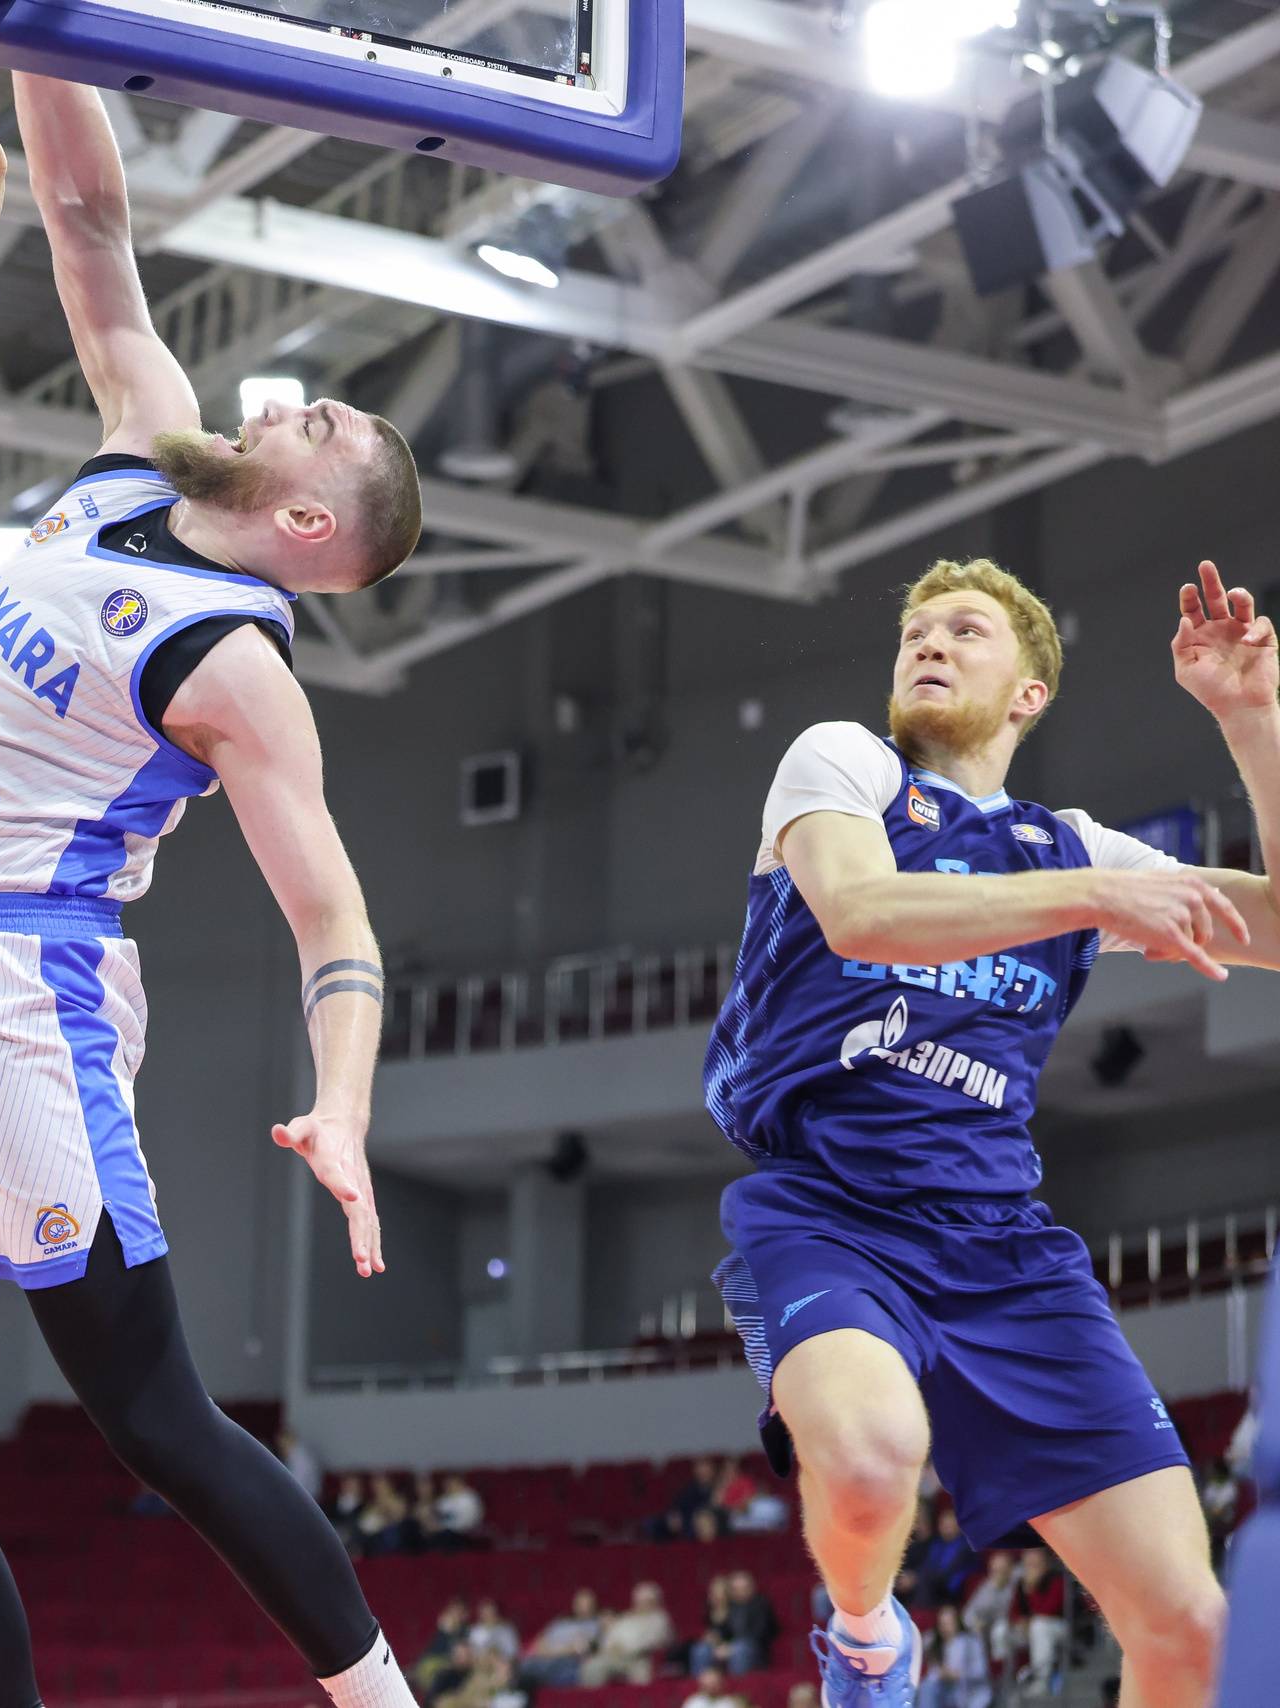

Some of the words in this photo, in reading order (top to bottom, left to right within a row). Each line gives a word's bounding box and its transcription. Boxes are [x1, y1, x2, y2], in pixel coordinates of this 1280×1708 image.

[410, 45, 446, 59] NAUTRONIC
[446, 53, 486, 67] SCOREBOARD
[486, 61, 509, 72] SYSTEM
